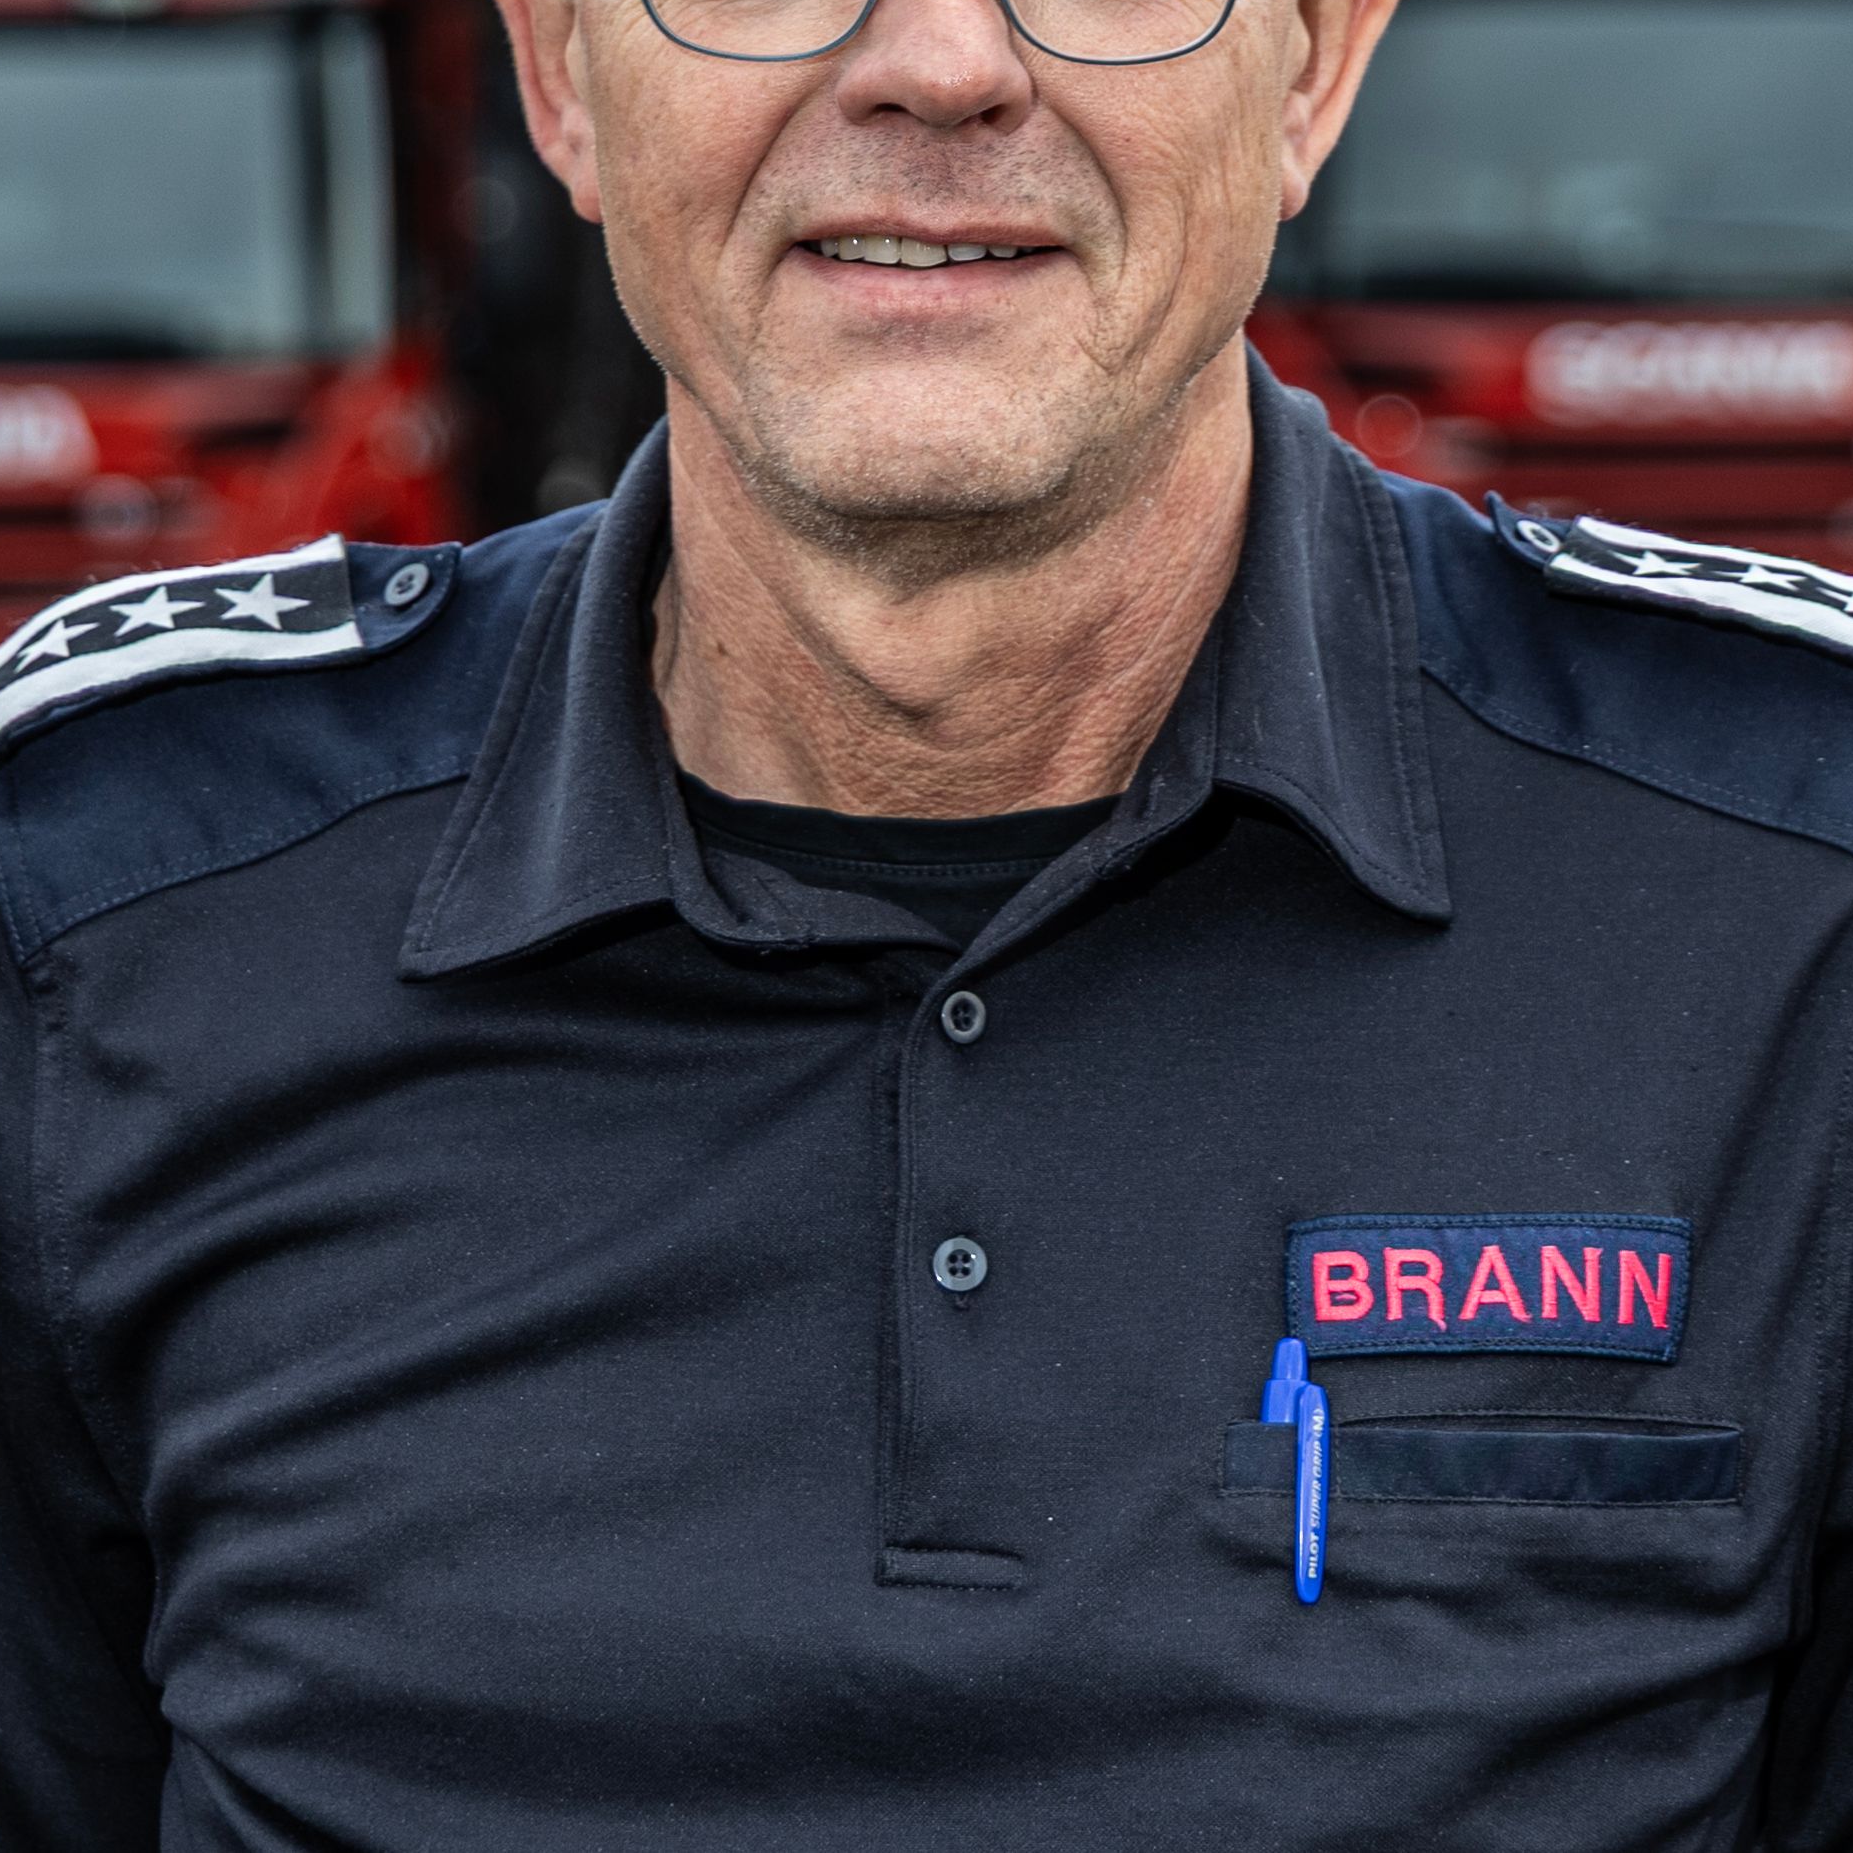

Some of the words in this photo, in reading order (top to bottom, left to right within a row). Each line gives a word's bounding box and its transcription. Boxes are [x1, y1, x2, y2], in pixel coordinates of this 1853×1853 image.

[1311, 1244, 1674, 1332] BRANN
[1313, 1409, 1325, 1438] (M)
[1313, 1441, 1323, 1478] GRIP
[1310, 1480, 1322, 1528] SUPER
[1308, 1532, 1320, 1578] PILOT
